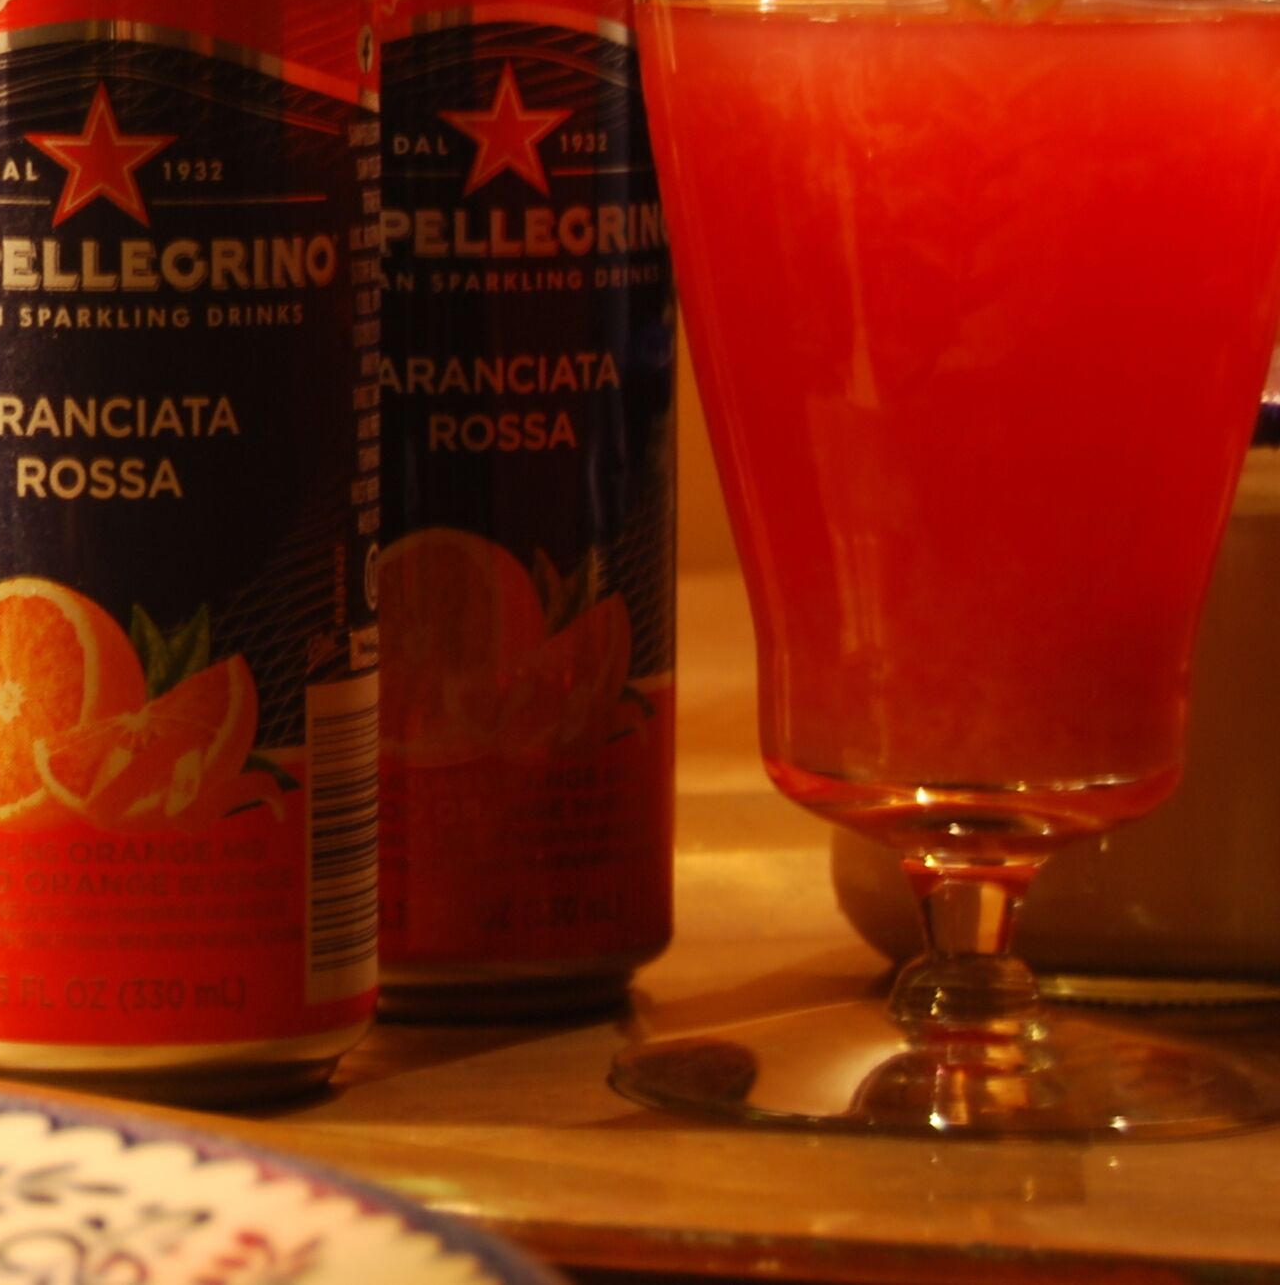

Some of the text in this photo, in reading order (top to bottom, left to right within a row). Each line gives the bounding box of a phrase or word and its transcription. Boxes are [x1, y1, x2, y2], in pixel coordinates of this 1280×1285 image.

[393, 133, 608, 156] DAL 1932
[162, 161, 223, 182] 1932
[379, 205, 667, 258] PELLEGRIN
[431, 271, 583, 293] SPARKLING
[19, 305, 191, 329] SPARKLING
[207, 305, 305, 328] DRINKS
[378, 353, 621, 395] ARANCIATA
[428, 412, 577, 453] ROSSA
[17, 457, 183, 499] ROSSA
[68, 839, 211, 865] ORANGE
[25, 869, 169, 896] ORANGE
[21, 977, 54, 1008] FL
[65, 978, 111, 1010] OZ
